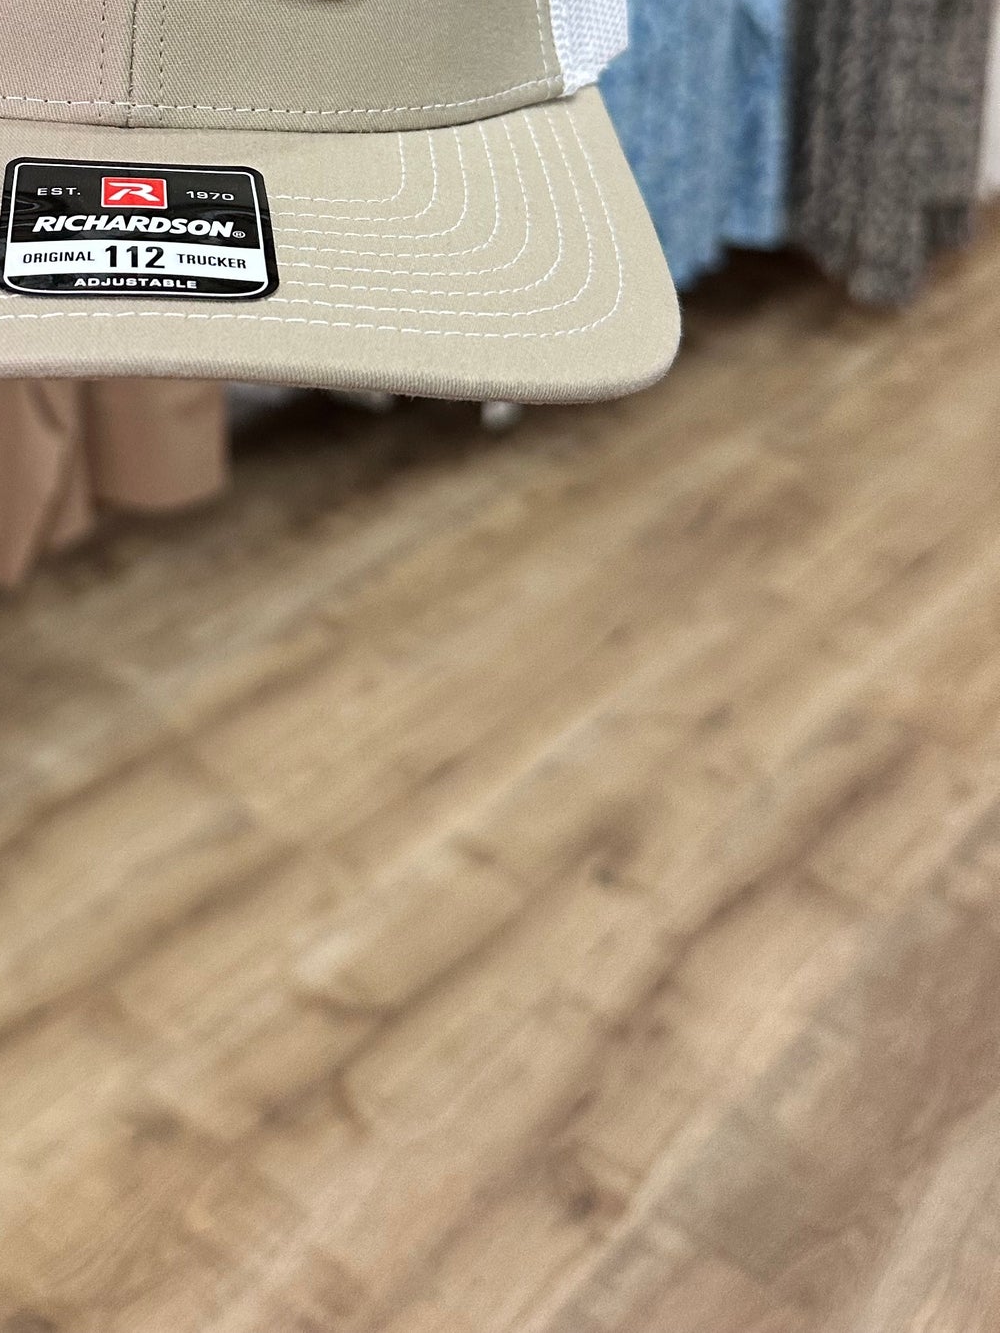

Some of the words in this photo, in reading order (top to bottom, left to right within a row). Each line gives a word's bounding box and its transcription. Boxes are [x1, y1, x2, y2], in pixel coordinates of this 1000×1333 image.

[37, 187, 81, 197] EST.
[186, 190, 235, 201] 1970
[22, 251, 95, 264] ORIGINAL
[104, 244, 165, 269] 112
[177, 253, 247, 269] TRUCKER
[74, 277, 197, 289] ADJUSTABLE
